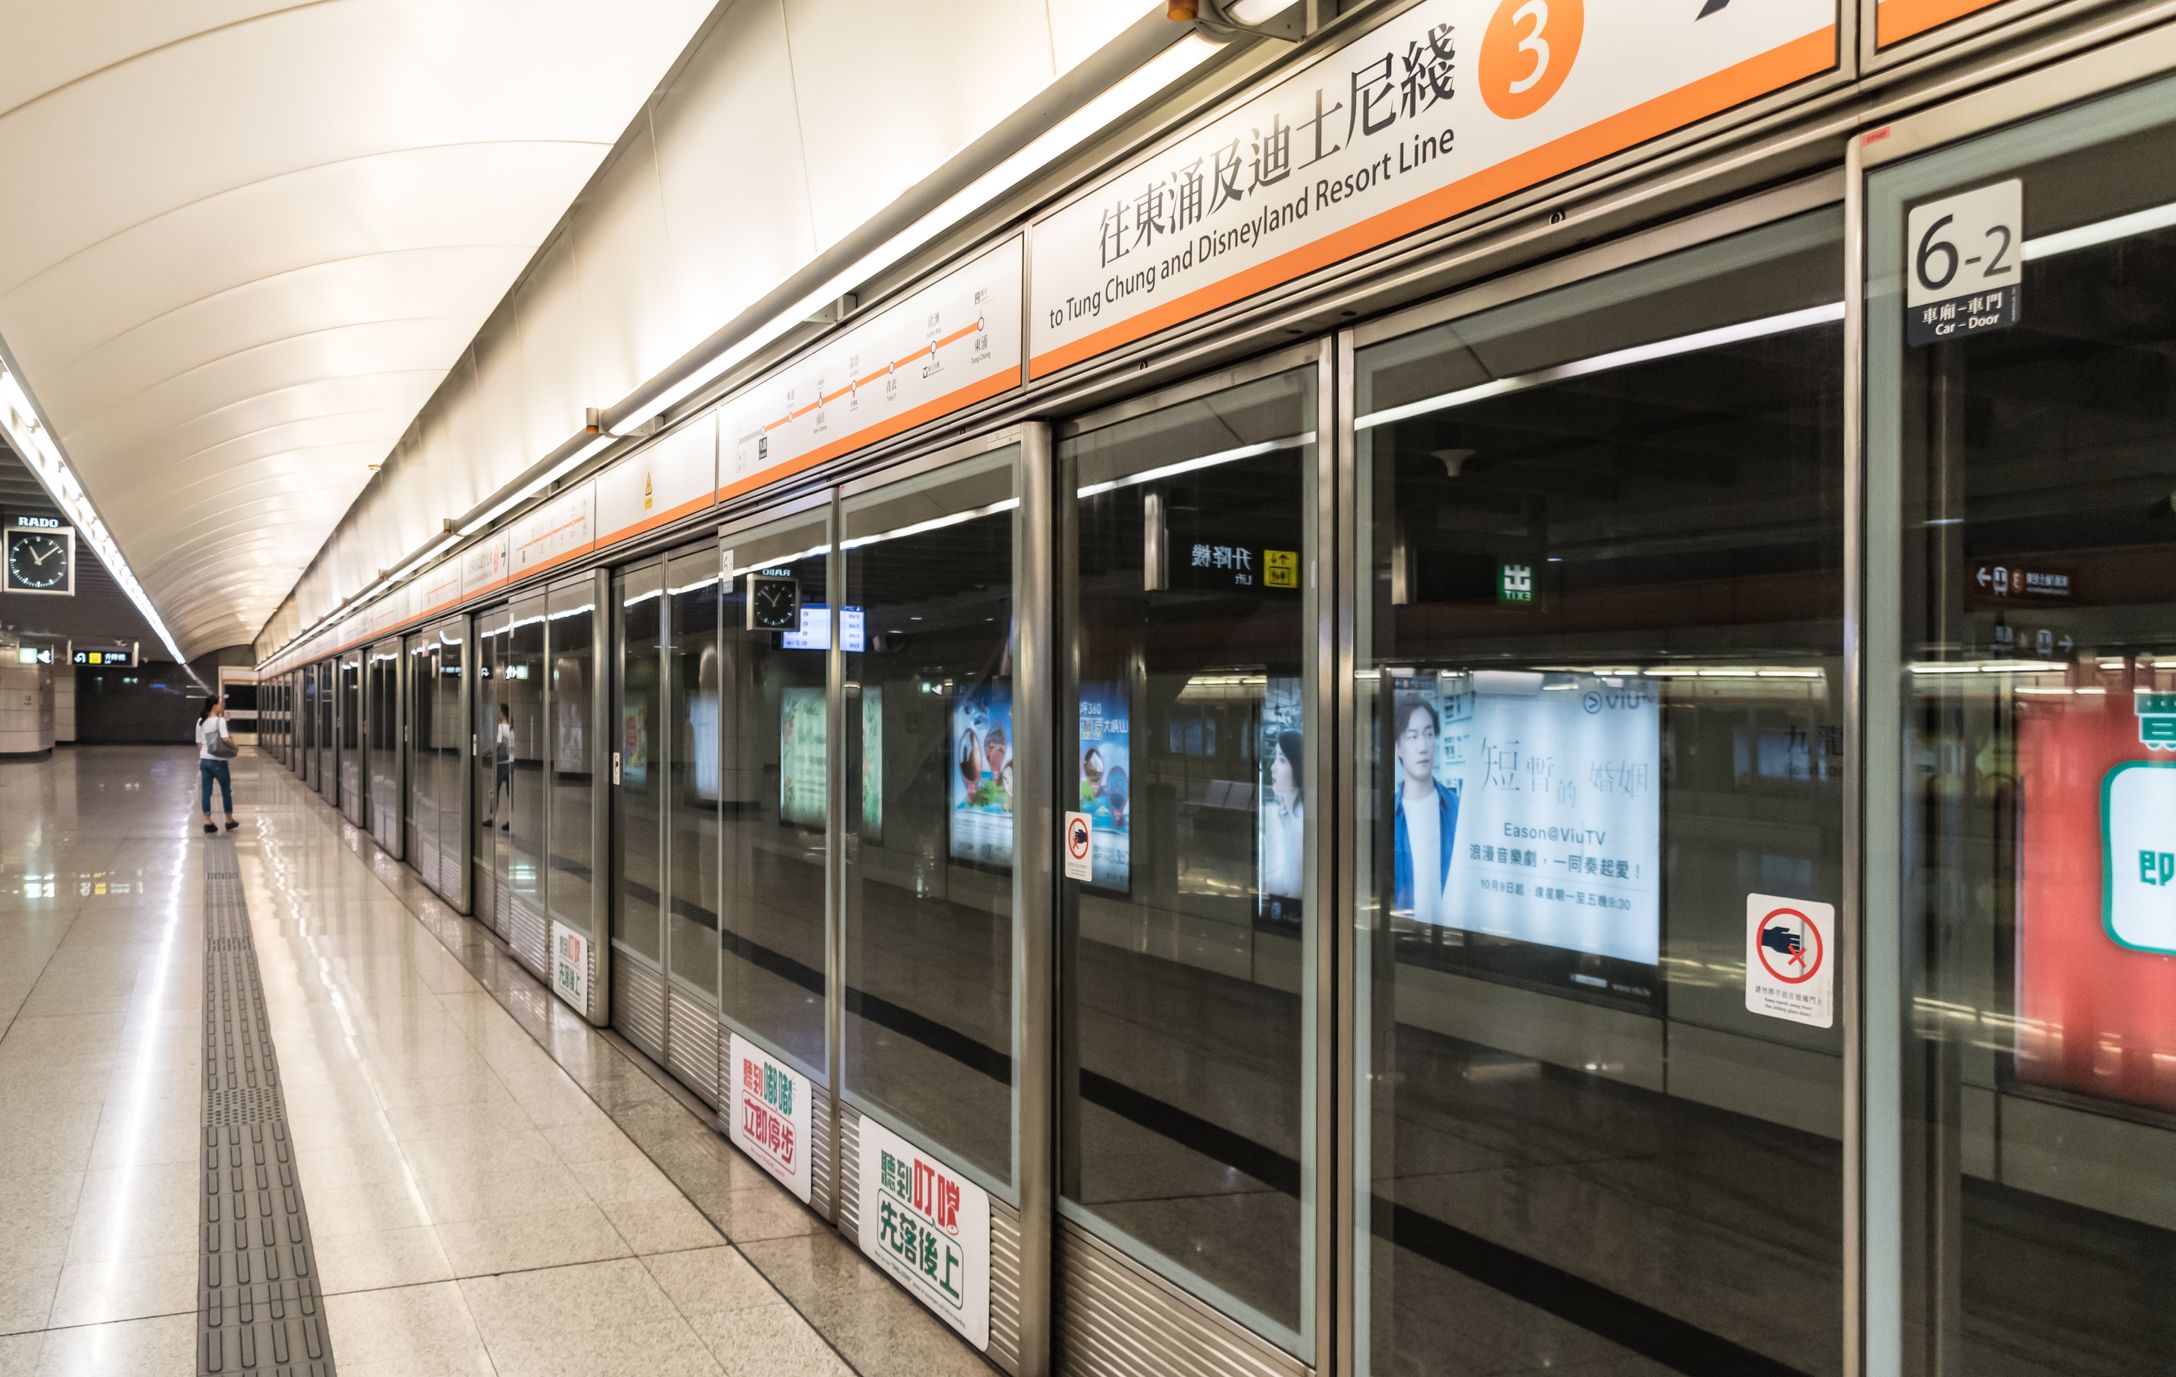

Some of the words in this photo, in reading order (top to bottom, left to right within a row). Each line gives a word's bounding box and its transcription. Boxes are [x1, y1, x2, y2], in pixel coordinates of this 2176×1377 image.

[1509, 0, 1550, 94] 3
[1050, 307, 1063, 329] to
[1066, 288, 1101, 322] Tung
[1105, 266, 1156, 304] Chung
[1161, 241, 1193, 279] and
[1199, 187, 1309, 263] Disneyland
[1316, 152, 1391, 212] Resort
[1399, 129, 1455, 174] Line
[1916, 214, 2012, 291] 6-2
[1935, 322, 1955, 336] Car
[1968, 313, 2000, 329] Door
[18, 516, 59, 528] RADO
[1504, 822, 1606, 846] Eason@ViuTV
[744, 1098, 794, 1165] 立即停步
[880, 1200, 960, 1300] 先落後上
